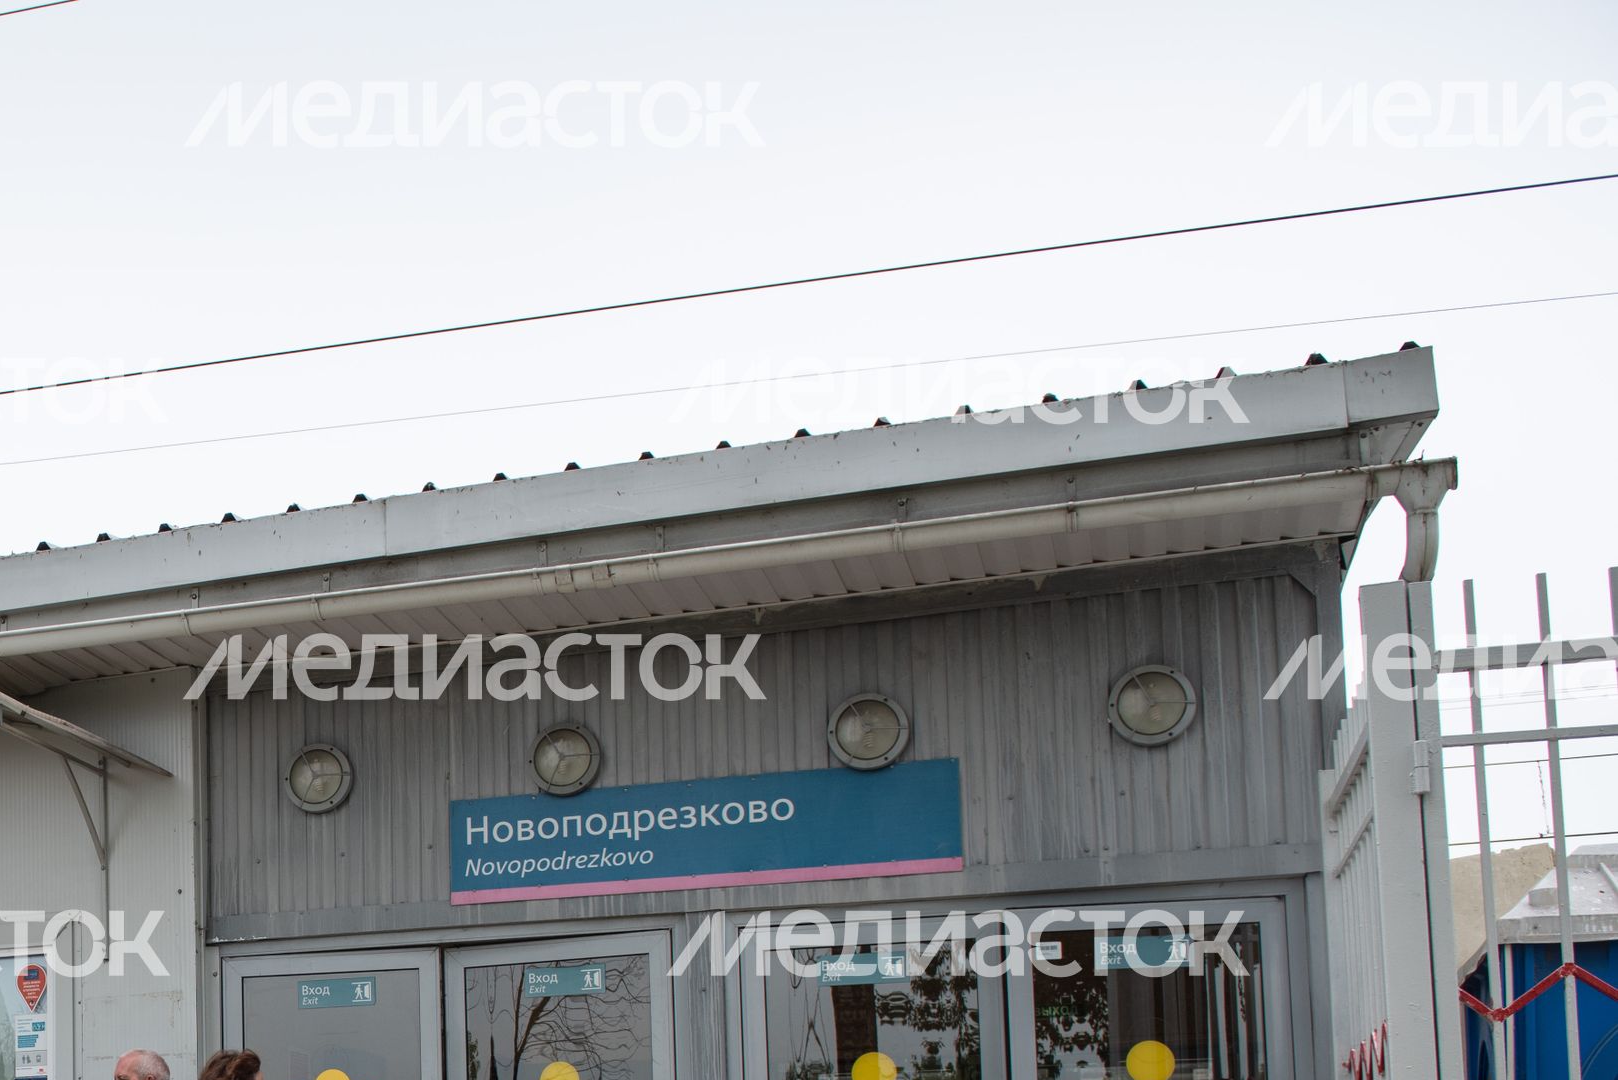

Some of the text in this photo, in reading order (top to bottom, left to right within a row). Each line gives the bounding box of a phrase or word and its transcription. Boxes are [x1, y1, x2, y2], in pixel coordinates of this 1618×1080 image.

[466, 797, 795, 845] Новоподрезково
[465, 848, 654, 878] Novopodrezkovo
[1100, 942, 1136, 954] Вход
[822, 960, 855, 972] Вход
[1101, 955, 1122, 965] Exit
[529, 973, 558, 985] Вход
[822, 974, 841, 982] Exit
[302, 984, 331, 997] Вход
[529, 984, 545, 994] Exit
[302, 996, 318, 1005] Exit
